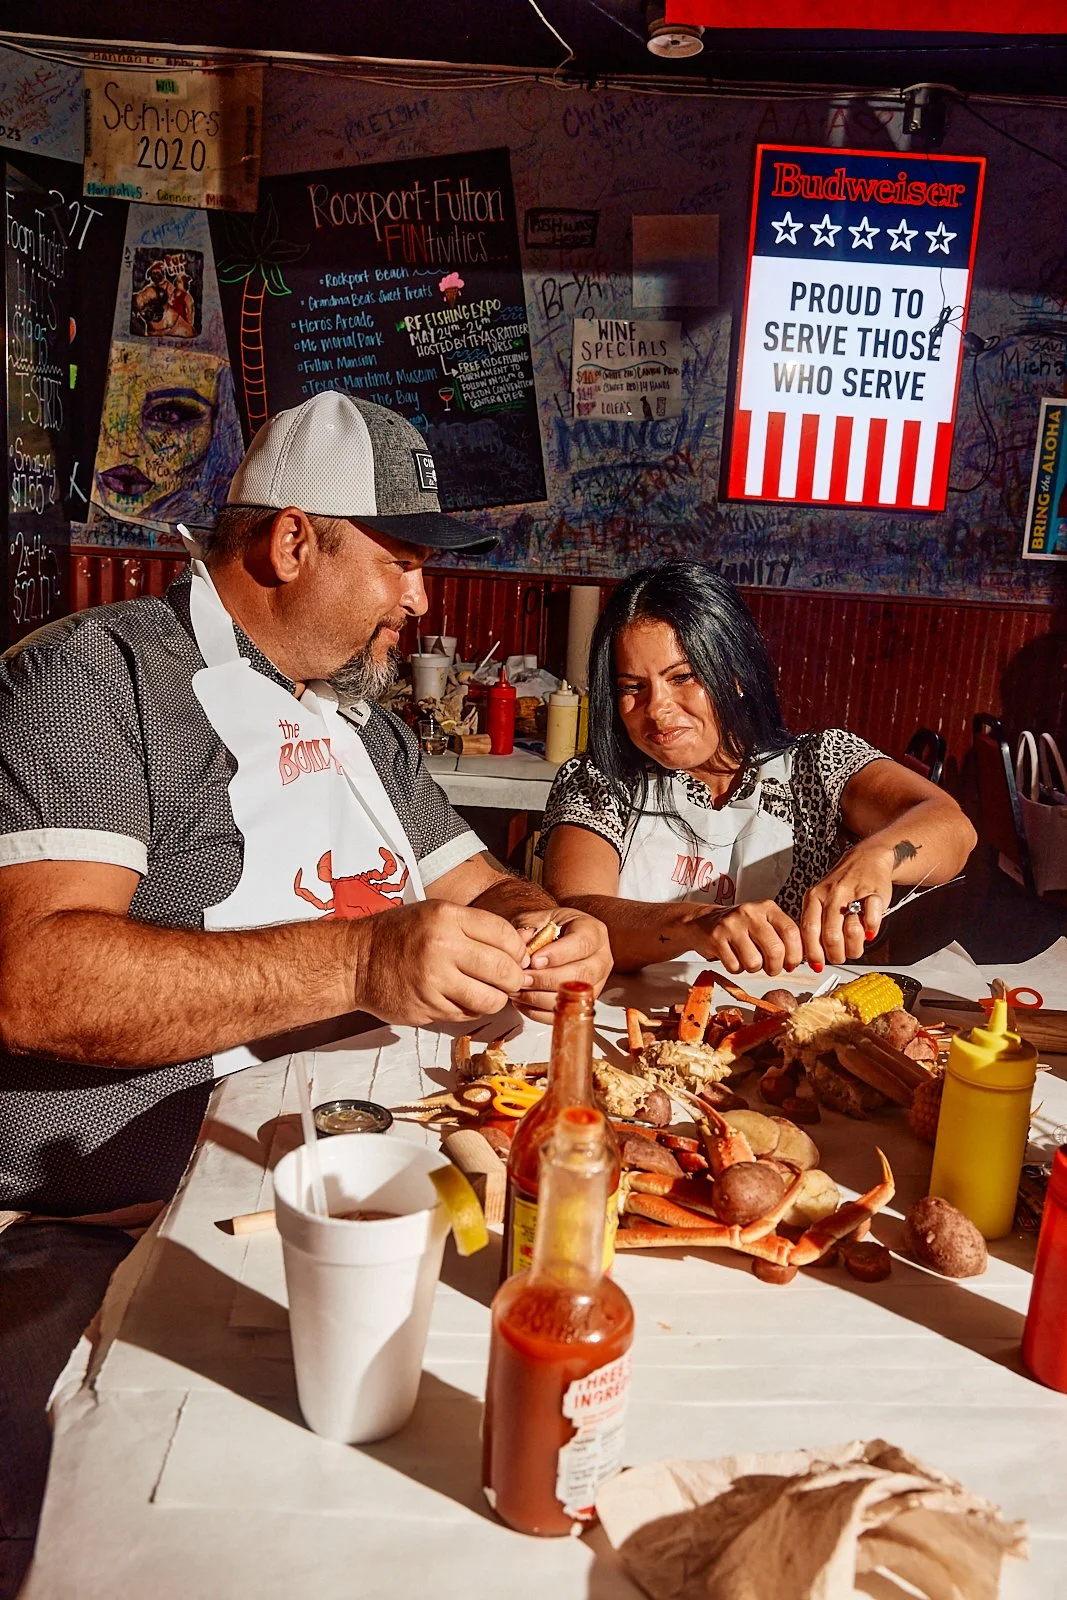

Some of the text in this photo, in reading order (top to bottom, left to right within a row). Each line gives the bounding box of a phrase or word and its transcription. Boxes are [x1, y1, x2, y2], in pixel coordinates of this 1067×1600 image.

[137, 136, 206, 172] 2020
[771, 162, 966, 208] Budweiser
[325, 266, 409, 290] Rockport Beach
[404, 284, 433, 302] Treats
[790, 281, 924, 319] PROUD TO
[336, 311, 375, 330] Arcade
[404, 299, 501, 332] RF FISHING EXPO
[359, 331, 385, 348] Park
[409, 327, 435, 346] MAY
[598, 319, 637, 341] WINE
[763, 321, 941, 361] SERVE THOSE
[416, 338, 454, 358] HOSTED
[454, 334, 468, 350] BY
[467, 328, 497, 347] TEXAS
[581, 340, 668, 361] SPECIALS
[304, 354, 378, 374] Fulton Mansion
[458, 360, 480, 374] FREE
[307, 377, 339, 394] Texas
[396, 367, 438, 385] Museum
[773, 361, 926, 402] WHO SERVE
[395, 389, 420, 412] Bay
[1031, 409, 1062, 550] BRING the ALOHA
[278, 719, 300, 739] the
